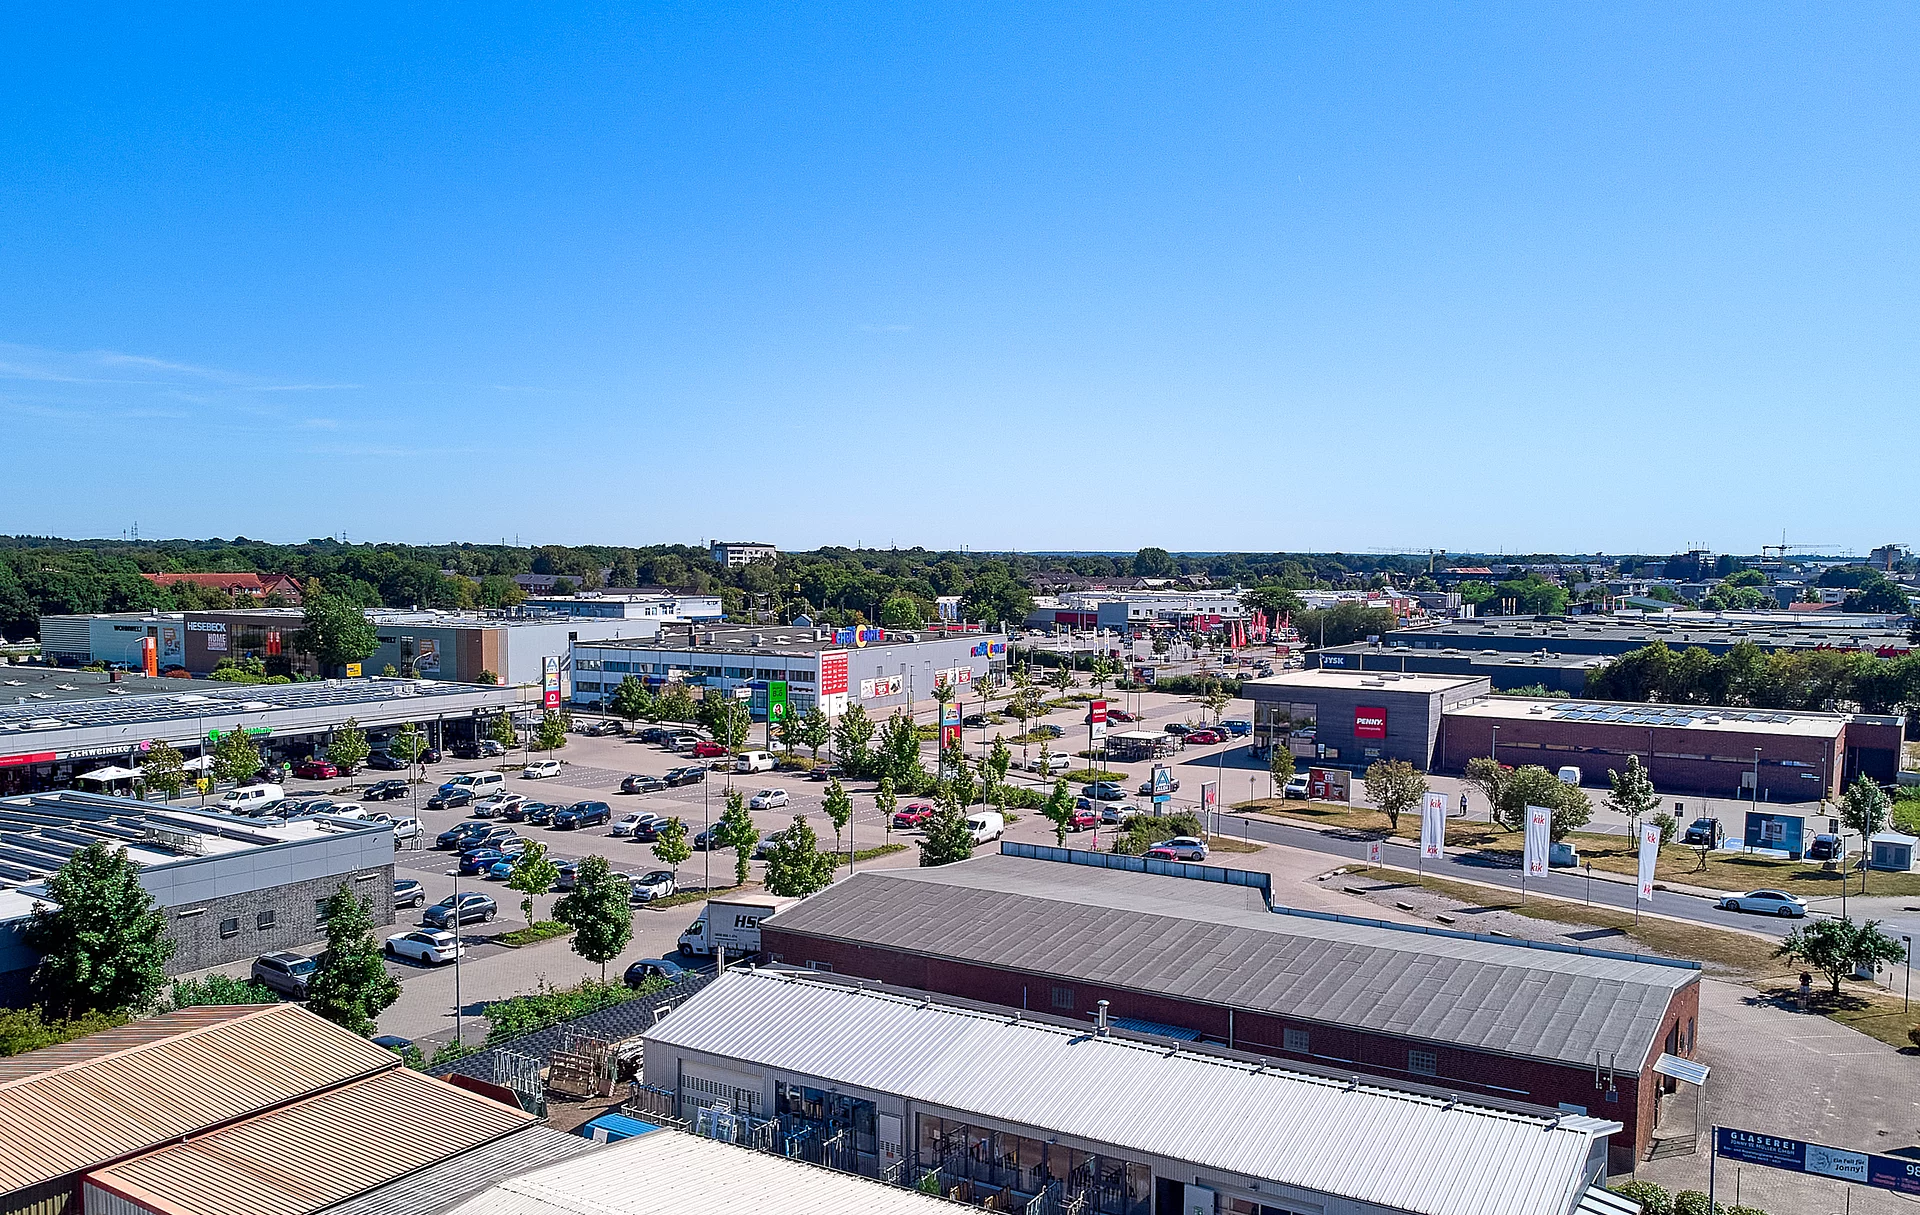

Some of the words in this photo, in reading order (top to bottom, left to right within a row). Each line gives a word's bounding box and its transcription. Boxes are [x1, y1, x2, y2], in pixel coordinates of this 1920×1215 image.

[187, 621, 227, 633] HESEBECK
[207, 634, 227, 643] HOME
[1323, 657, 1344, 665] JYSK
[1430, 798, 1442, 809] kik
[1533, 812, 1546, 825] kik
[1426, 844, 1439, 855] kik
[1530, 861, 1543, 873] kik
[1730, 1131, 1796, 1150] GLASEREI
[1835, 1164, 1864, 1173] Jonny!
